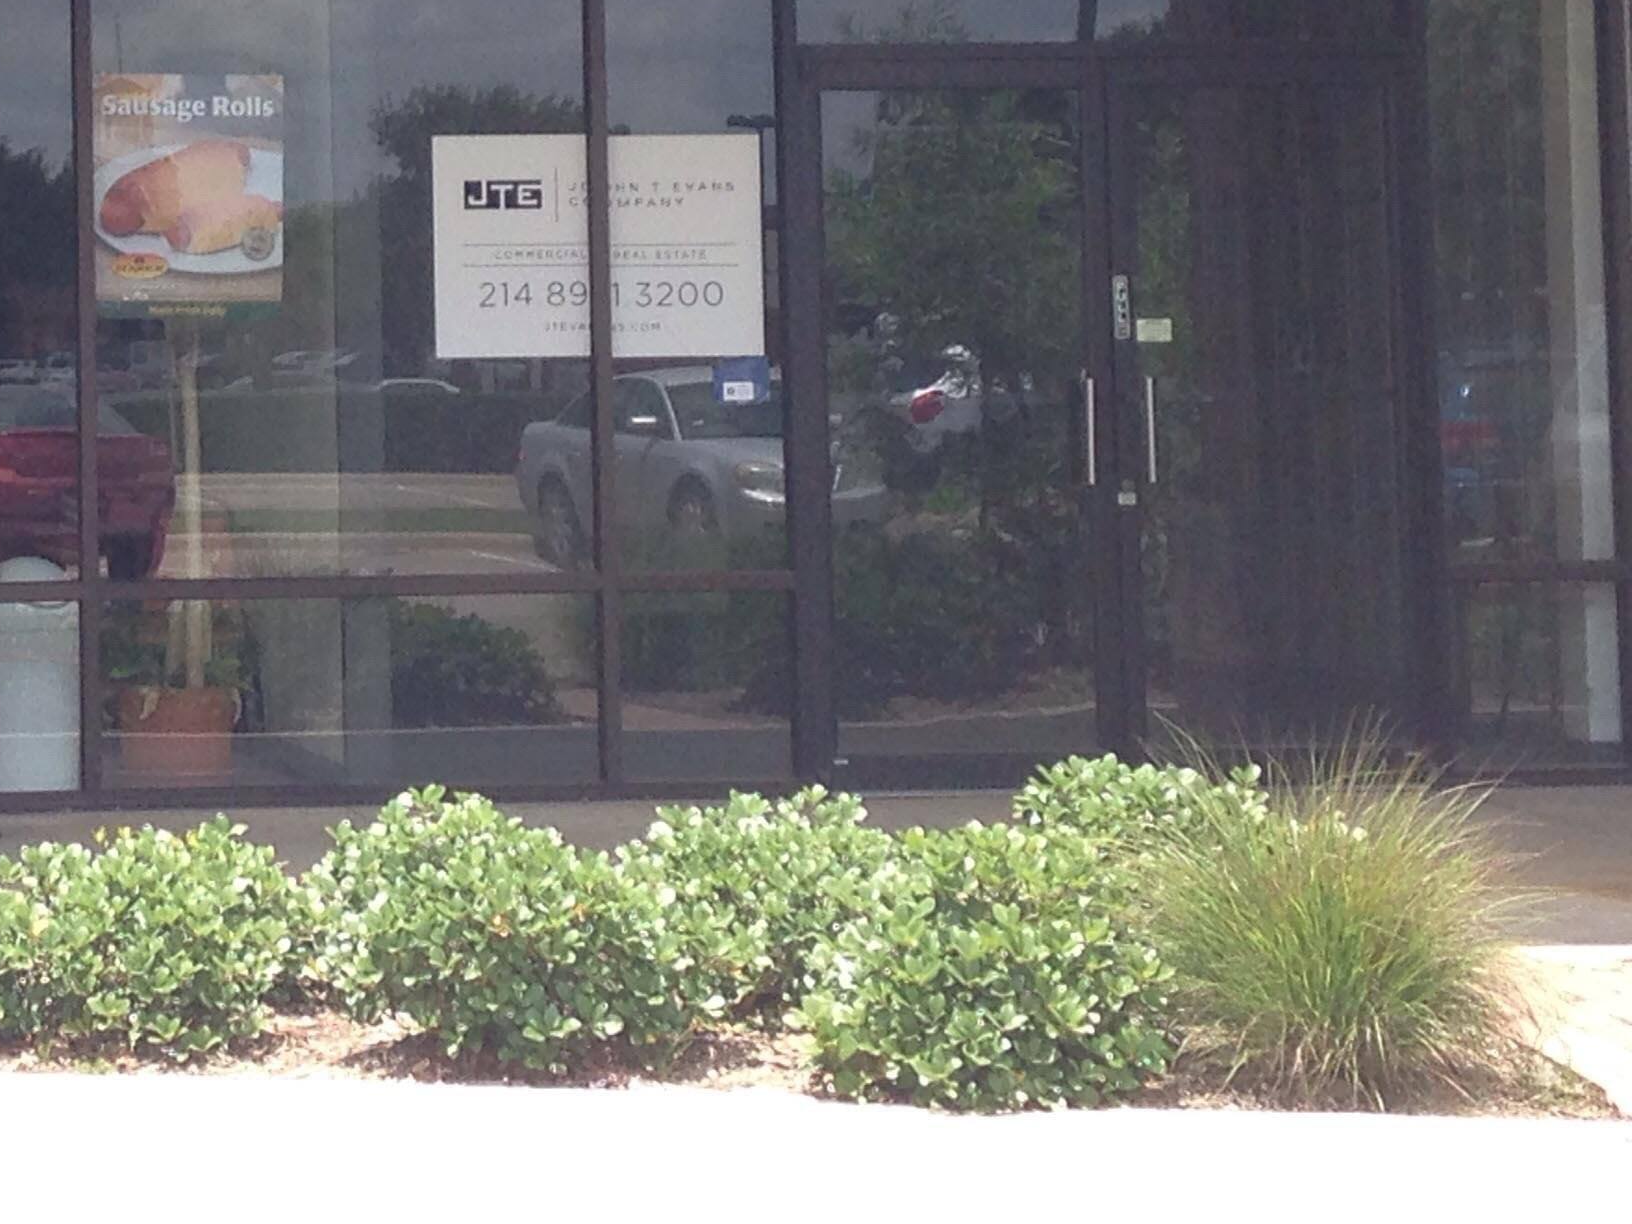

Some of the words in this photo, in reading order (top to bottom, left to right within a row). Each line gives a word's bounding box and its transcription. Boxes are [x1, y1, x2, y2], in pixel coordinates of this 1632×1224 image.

[102, 94, 206, 123] Sausage
[212, 95, 275, 117] Rolls
[466, 180, 540, 208] JTE
[655, 249, 708, 260] ESTATE
[478, 281, 533, 308] 214
[635, 280, 724, 307] 3200
